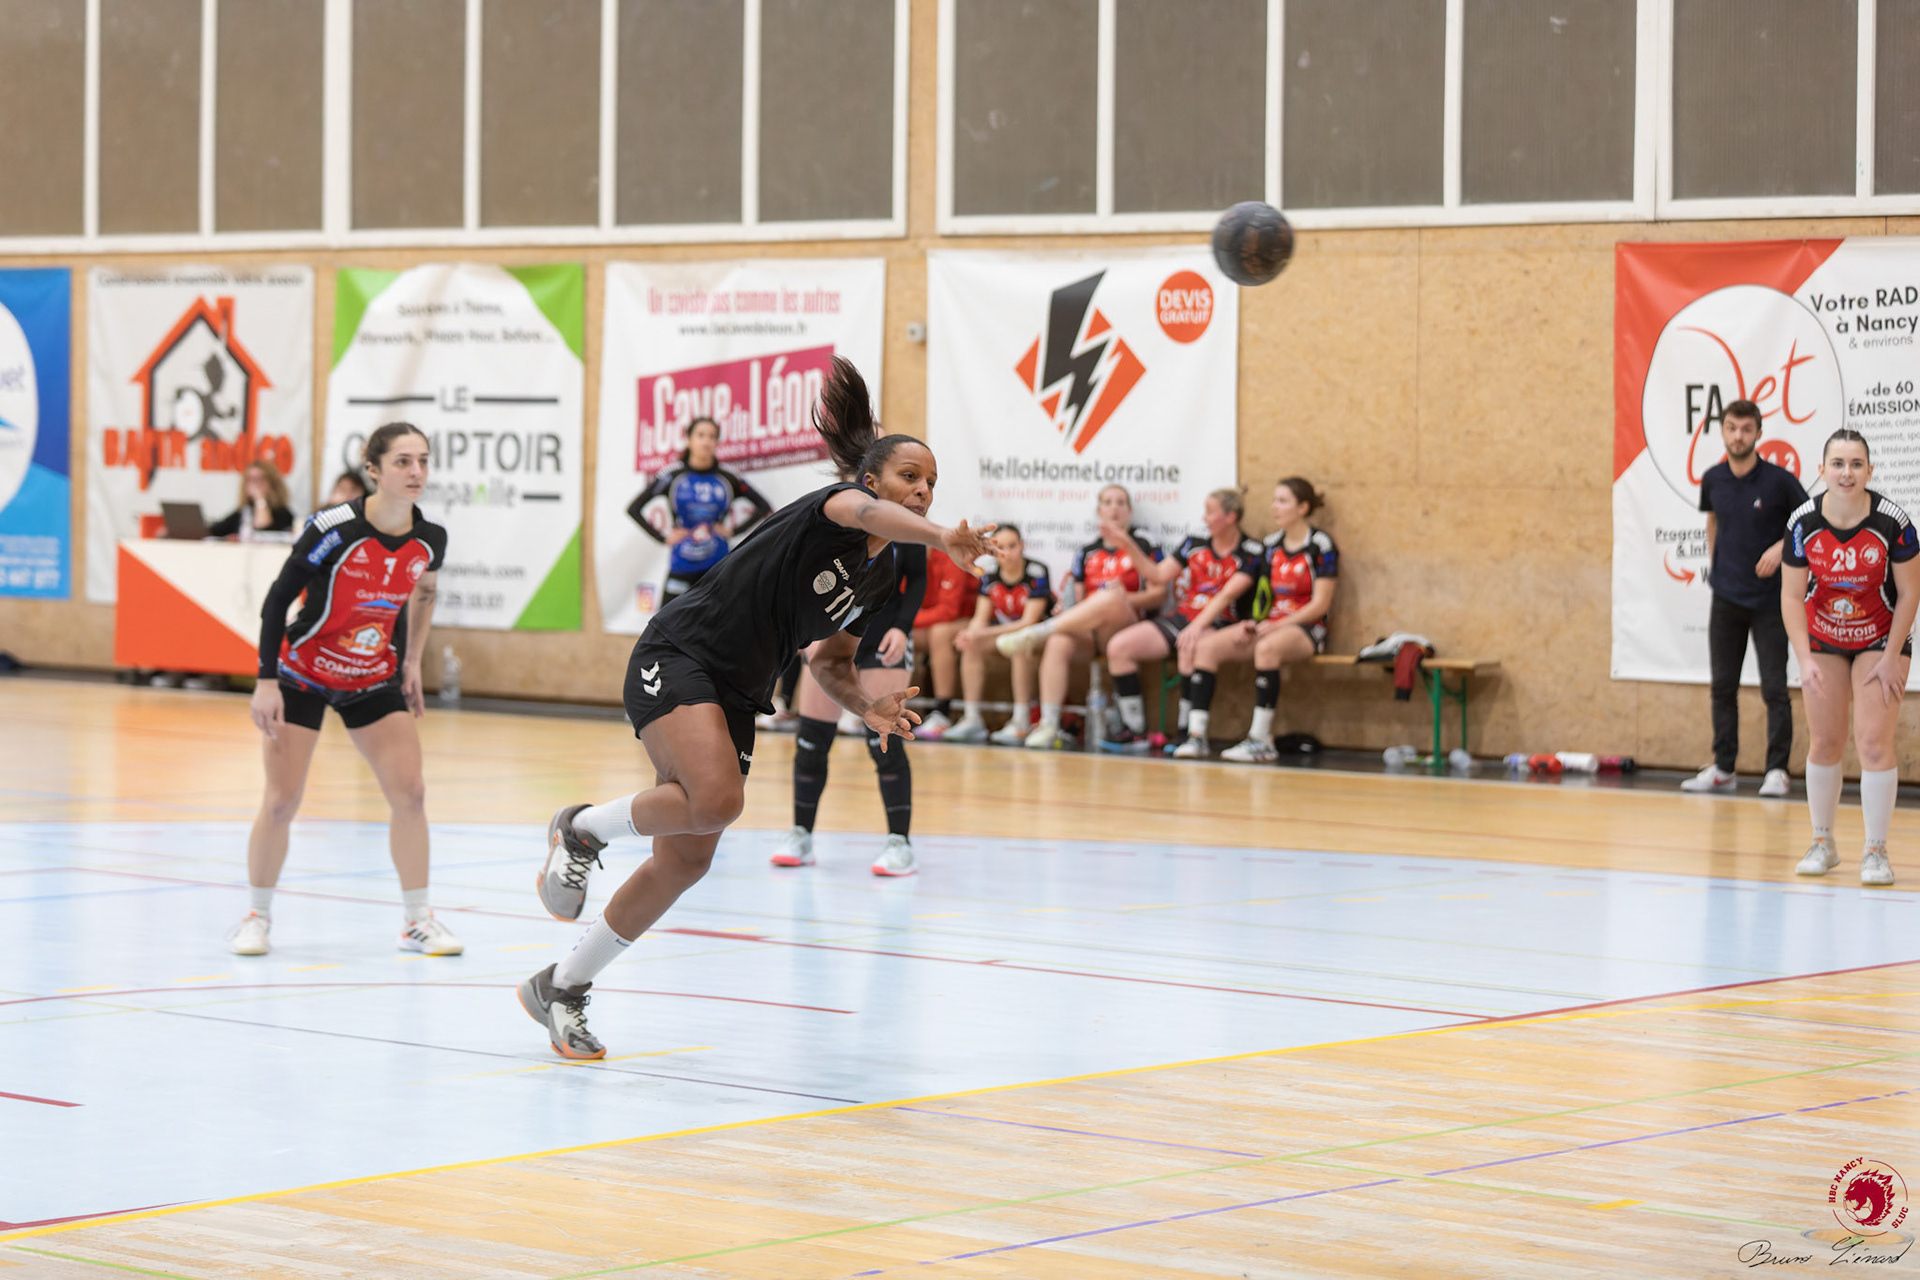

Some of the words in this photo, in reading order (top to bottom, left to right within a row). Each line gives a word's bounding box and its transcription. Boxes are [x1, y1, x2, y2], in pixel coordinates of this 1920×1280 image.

[1160, 289, 1211, 309] DEVIS
[1811, 294, 1869, 312] Votre
[1876, 286, 1919, 307] RAD
[1160, 310, 1210, 324] GRATUIT
[1836, 316, 1849, 333] à
[1857, 314, 1918, 334] Nancy
[1849, 336, 1857, 349] &
[1863, 335, 1914, 349] environs
[1896, 380, 1914, 395] 60
[440, 387, 469, 412] LE
[653, 374, 732, 455] Cave
[750, 356, 824, 438] Léon
[979, 457, 1180, 482] HelloHomeLorraine
[833, 558, 849, 578] CRAFT
[1831, 546, 1857, 572] 28
[825, 586, 856, 622] 11
[1814, 615, 1878, 638] COMPTOIR
